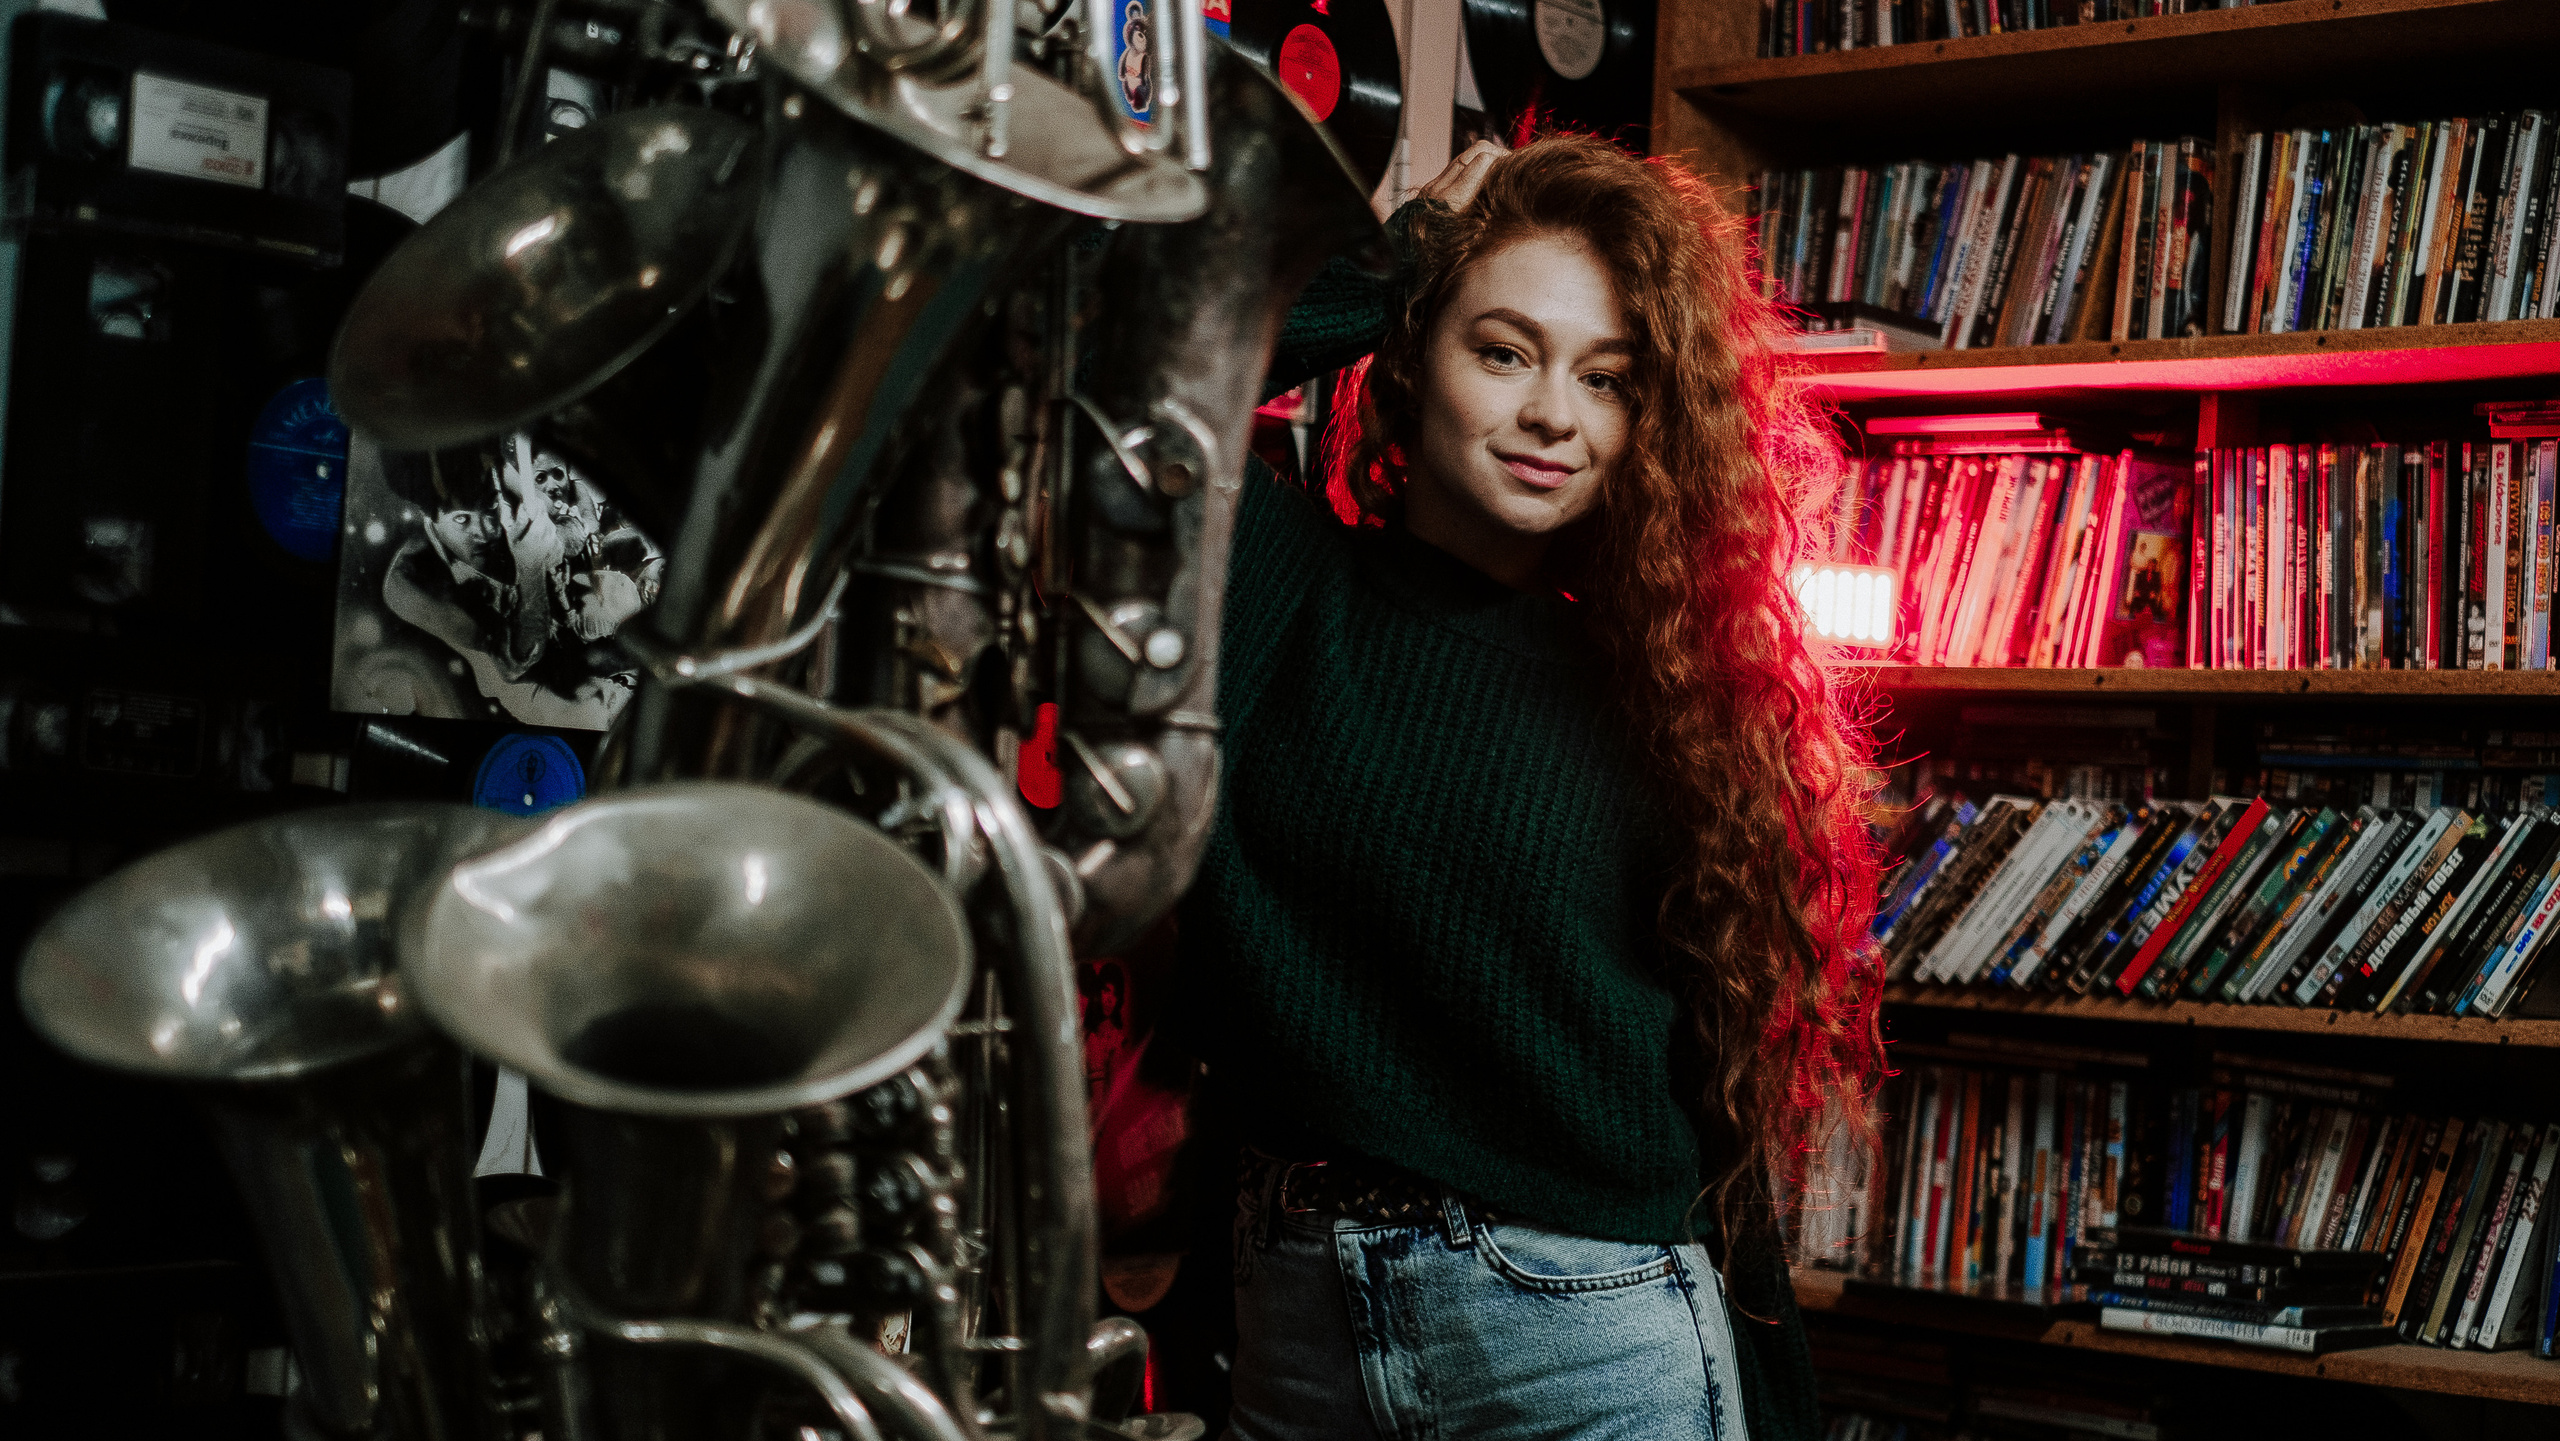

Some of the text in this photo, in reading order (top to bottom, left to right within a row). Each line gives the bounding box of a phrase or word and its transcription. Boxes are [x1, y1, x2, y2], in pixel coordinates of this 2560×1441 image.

[2459, 190, 2489, 282] РЕСТЛЕР
[2494, 232, 2511, 278] ДЕТКИ
[2505, 164, 2522, 220] ПОРЯДКЕ
[2470, 502, 2484, 591] Непобедимые
[2537, 534, 2549, 559] DVD
[2130, 848, 2208, 949] БУМЕР
[2510, 861, 2529, 881] 12
[2345, 906, 2396, 968] КАПИТАН
[2358, 887, 2433, 979] ИДЕАЛЬНЫЙ
[2423, 847, 2467, 896] ПОБЕГ
[2513, 928, 2535, 954] БИН
[2530, 911, 2547, 930] НА
[2116, 1253, 2133, 1271] 13
[2139, 1252, 2191, 1276] РАЙОН
